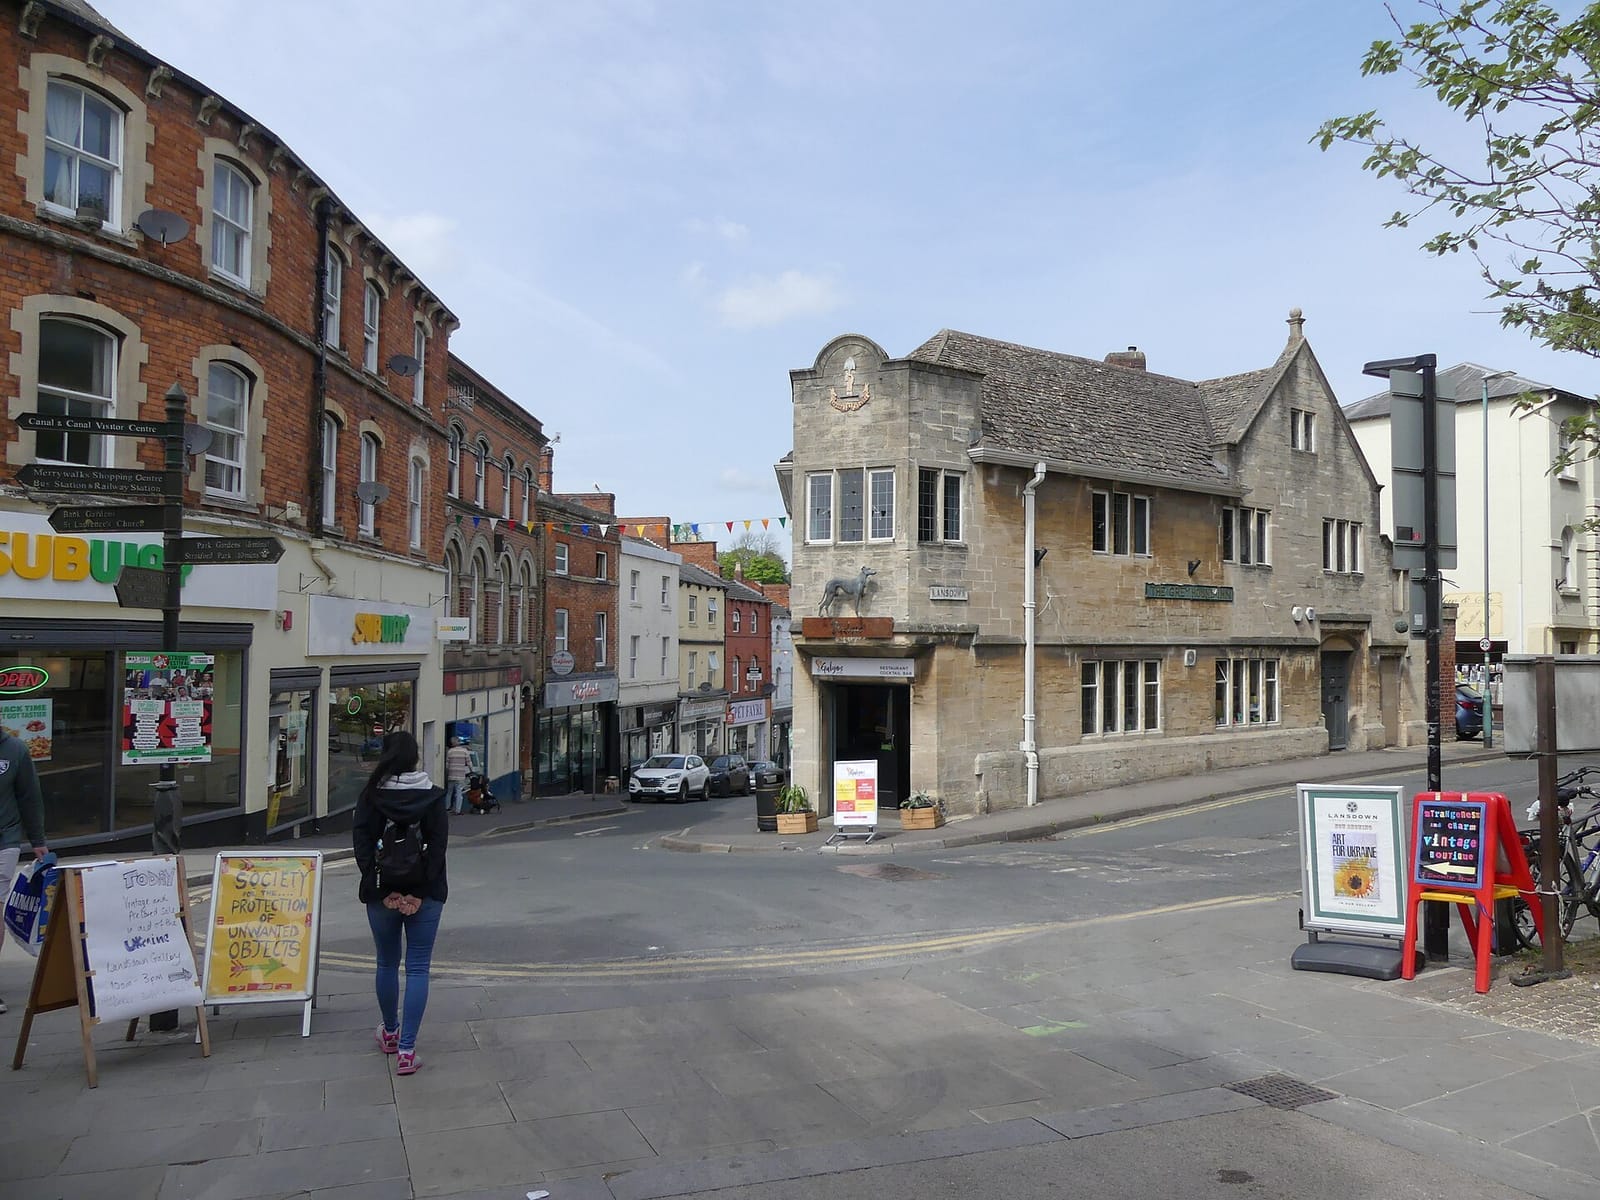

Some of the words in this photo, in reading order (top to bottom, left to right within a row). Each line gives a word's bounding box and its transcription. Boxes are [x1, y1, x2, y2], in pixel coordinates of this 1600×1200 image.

[28, 417, 54, 426] Canal
[66, 419, 91, 429] Canal
[96, 421, 124, 431] Visitor
[128, 424, 157, 433] Centre
[33, 468, 90, 479] Merrywalks
[92, 471, 133, 482] Shopping
[135, 474, 163, 482] Centre
[54, 480, 87, 489] Station
[94, 482, 129, 491] Railway
[130, 484, 161, 492] Station
[85, 510, 115, 518] Gardens
[0, 531, 193, 587] UBWA
[352, 612, 411, 645] SUBWAY
[1480, 640, 1490, 648] 20
[0, 672, 40, 687] OPEN
[0, 705, 23, 713] ACK
[24, 704, 48, 712] TIME
[1332, 833, 1346, 845] ART
[1423, 833, 1477, 849] vintage
[1332, 845, 1346, 857] FOR
[1346, 845, 1377, 859] UKRAINE
[122, 867, 176, 889] TODAY
[235, 870, 309, 897] SOCIETY
[231, 898, 308, 915] PROTECTION
[259, 913, 277, 923] OF
[228, 923, 300, 939] UNWANTED
[228, 940, 301, 960] OBJECTS
